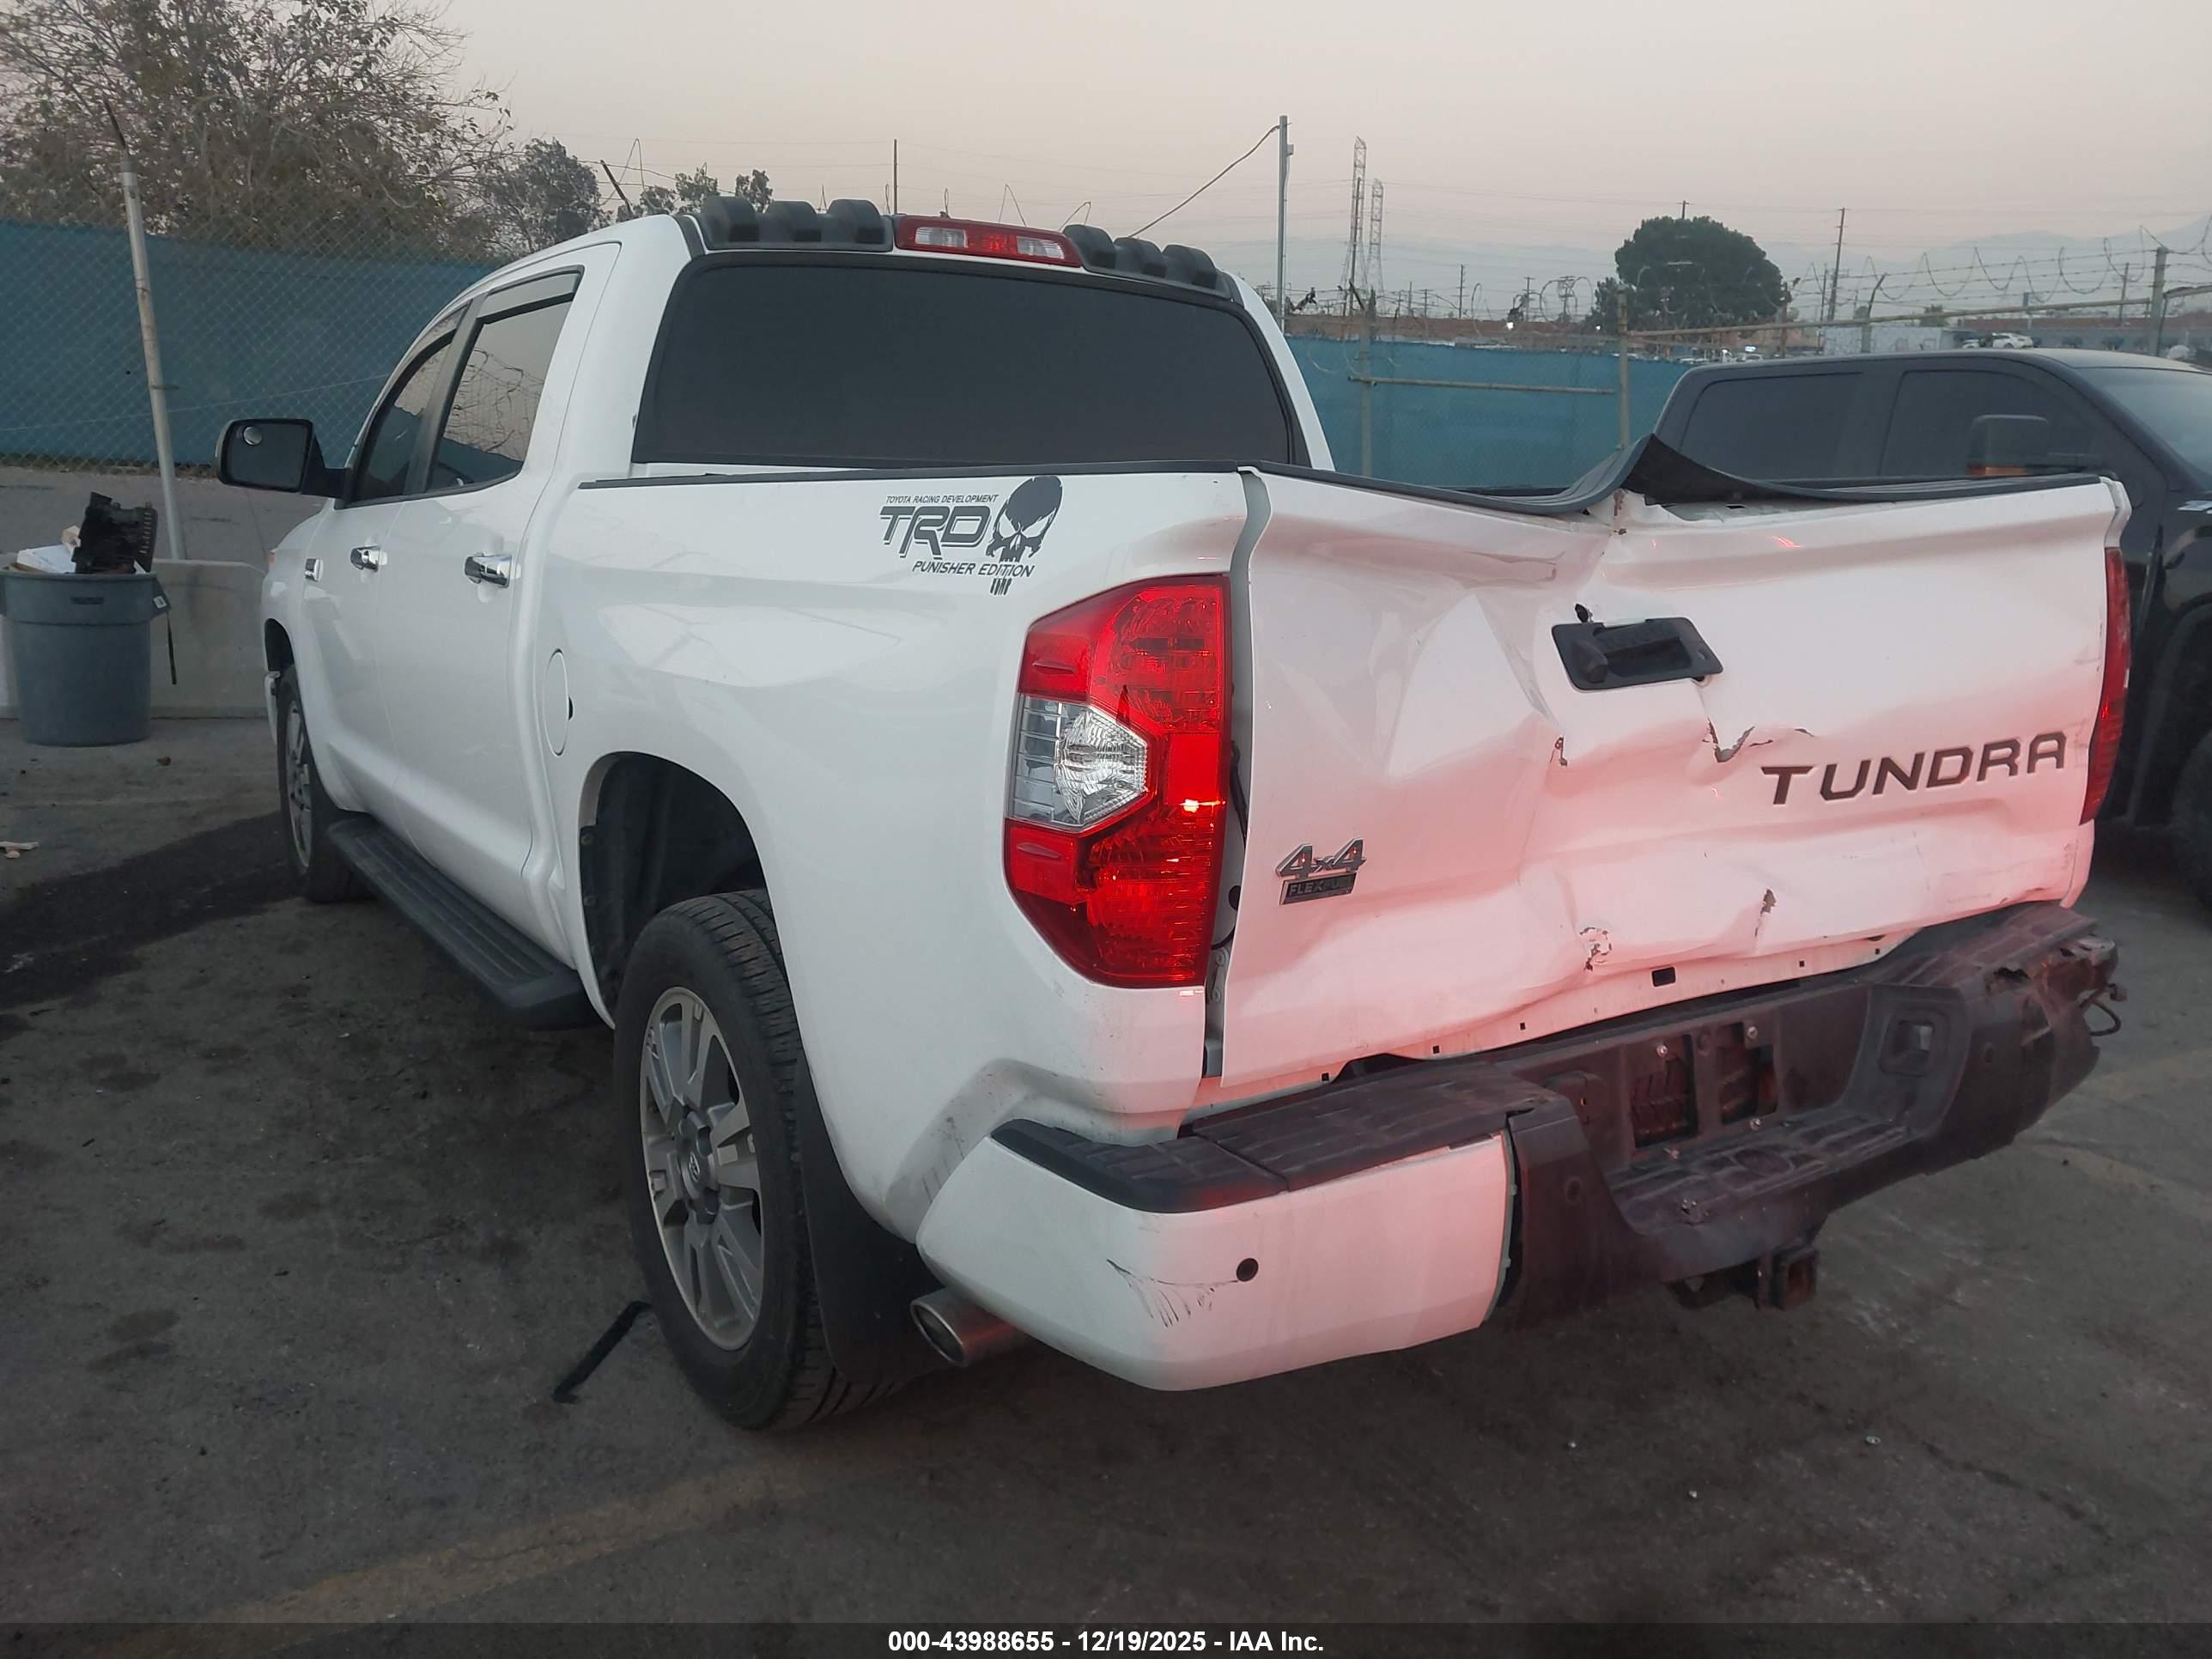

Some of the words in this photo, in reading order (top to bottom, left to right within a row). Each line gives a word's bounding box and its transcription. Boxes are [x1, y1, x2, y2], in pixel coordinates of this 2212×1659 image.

[886, 495, 911, 504] TOYOTA
[941, 495, 1000, 503] DEVELOPMENT
[880, 506, 991, 559] TRD
[912, 561, 975, 575] PUNISHER
[978, 563, 1035, 577] EDITION
[1761, 731, 2066, 805] TUNDRA
